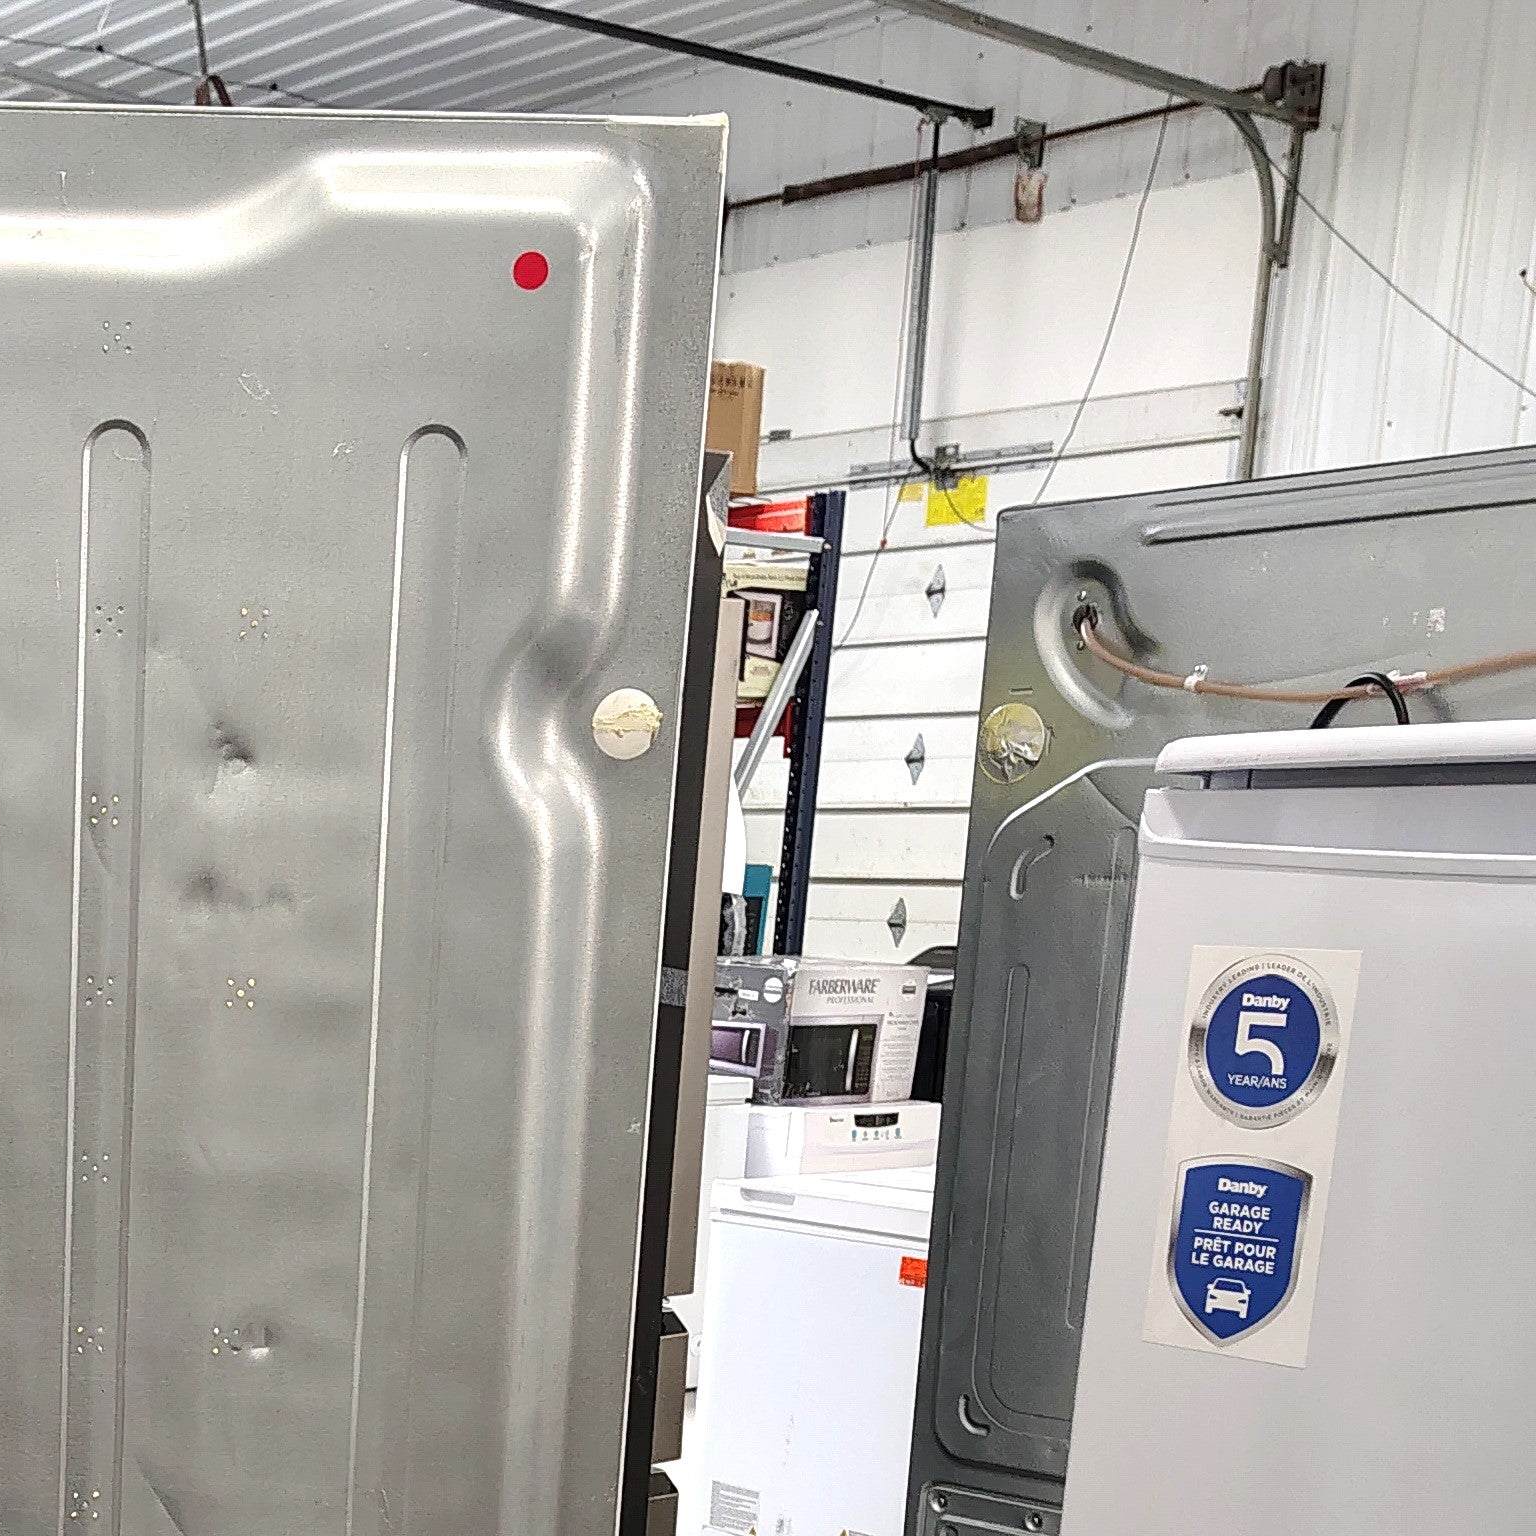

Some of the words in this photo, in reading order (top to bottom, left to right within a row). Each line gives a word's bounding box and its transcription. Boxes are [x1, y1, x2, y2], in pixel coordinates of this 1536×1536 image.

[1267, 962, 1296, 975] LEADER
[808, 978, 878, 995] FARBERWARE
[1241, 992, 1291, 1011] Danby
[1234, 1011, 1288, 1076] 5
[1227, 1073, 1287, 1089] YEAR/ANS
[1217, 1177, 1268, 1198] Danby
[1208, 1201, 1271, 1220] GARAGE
[1212, 1216, 1263, 1234] READY
[1193, 1236, 1232, 1253] PRÊT
[1234, 1242, 1277, 1259] POUR
[1191, 1251, 1210, 1265] LE
[1212, 1255, 1276, 1275] GARAGE
